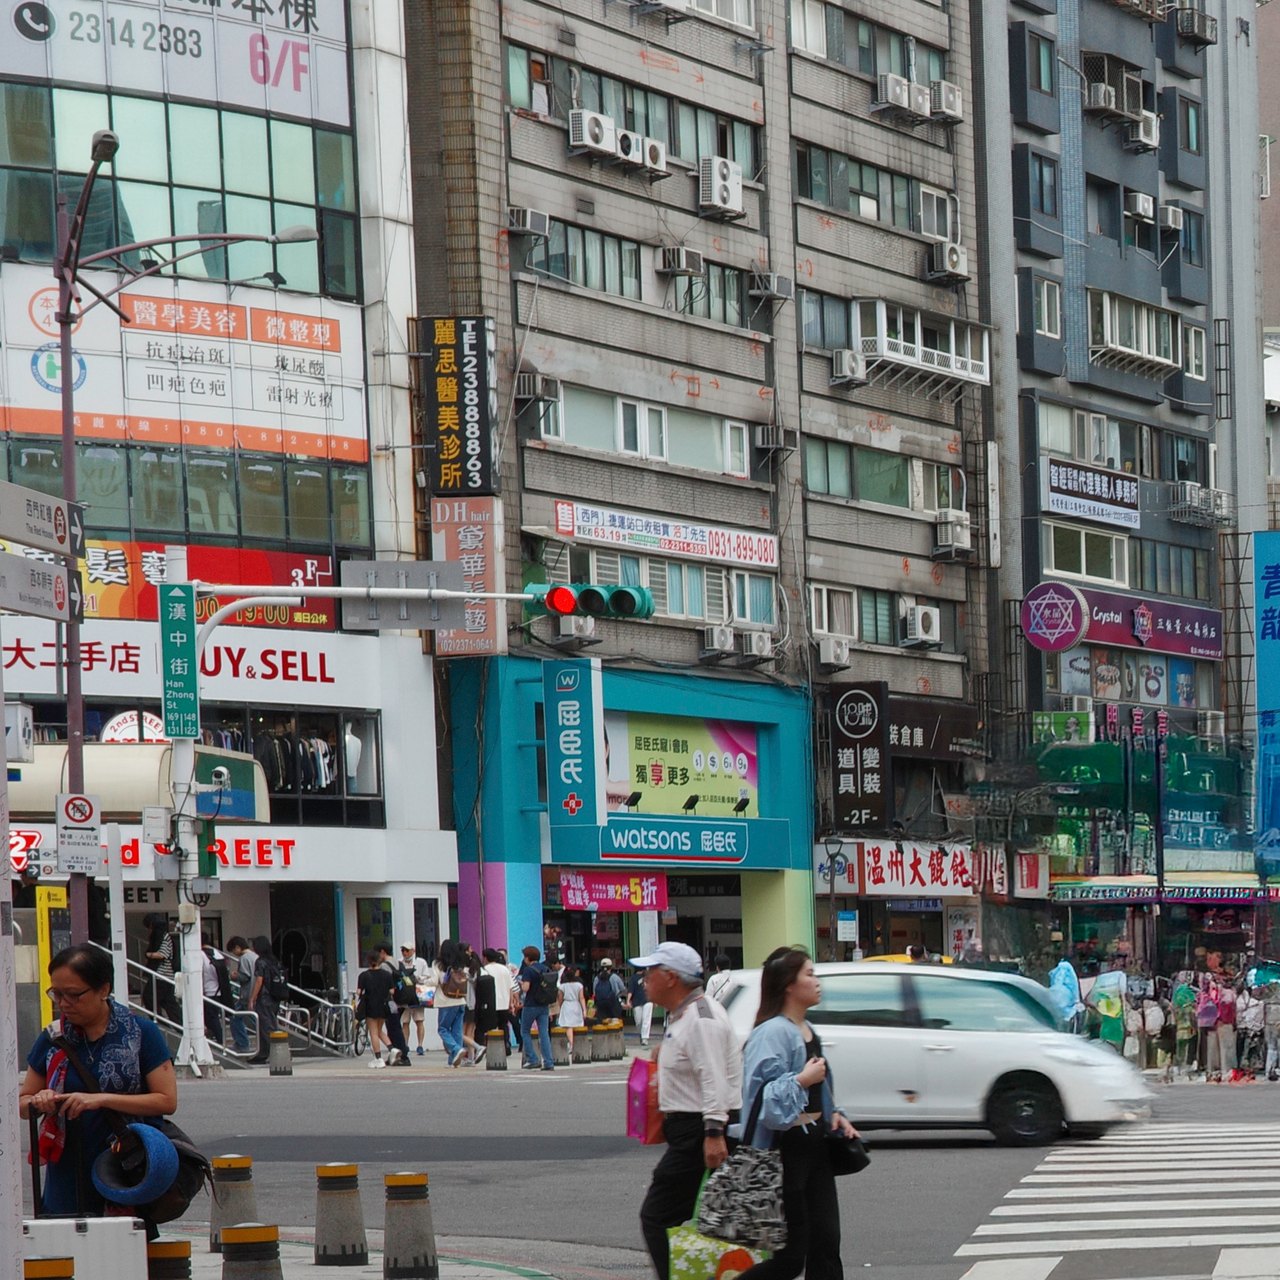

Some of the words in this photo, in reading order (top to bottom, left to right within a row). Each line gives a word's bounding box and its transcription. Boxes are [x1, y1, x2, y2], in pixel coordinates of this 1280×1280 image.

[69, 12, 135, 48] 2314
[142, 22, 202, 58] 2383
[249, 33, 309, 92] 6/F
[133, 300, 237, 332] 醫學美容
[265, 316, 332, 346] 微整型
[274, 354, 325, 377] 玻尿酸
[434, 319, 462, 489] 麗思醫美診所
[708, 530, 775, 563] 0931-899-080
[1093, 607, 1122, 624] Crystal
[168, 603, 189, 676] 漢中街
[166, 680, 184, 688] Han
[166, 690, 194, 701] Zhong
[167, 713, 179, 721] 169
[184, 713, 196, 721] 148
[167, 726, 179, 735] 131
[184, 726, 197, 735] 122
[558, 700, 583, 784] 屈臣氏
[611, 828, 691, 851] watsons
[700, 831, 737, 852] 屈臣氏
